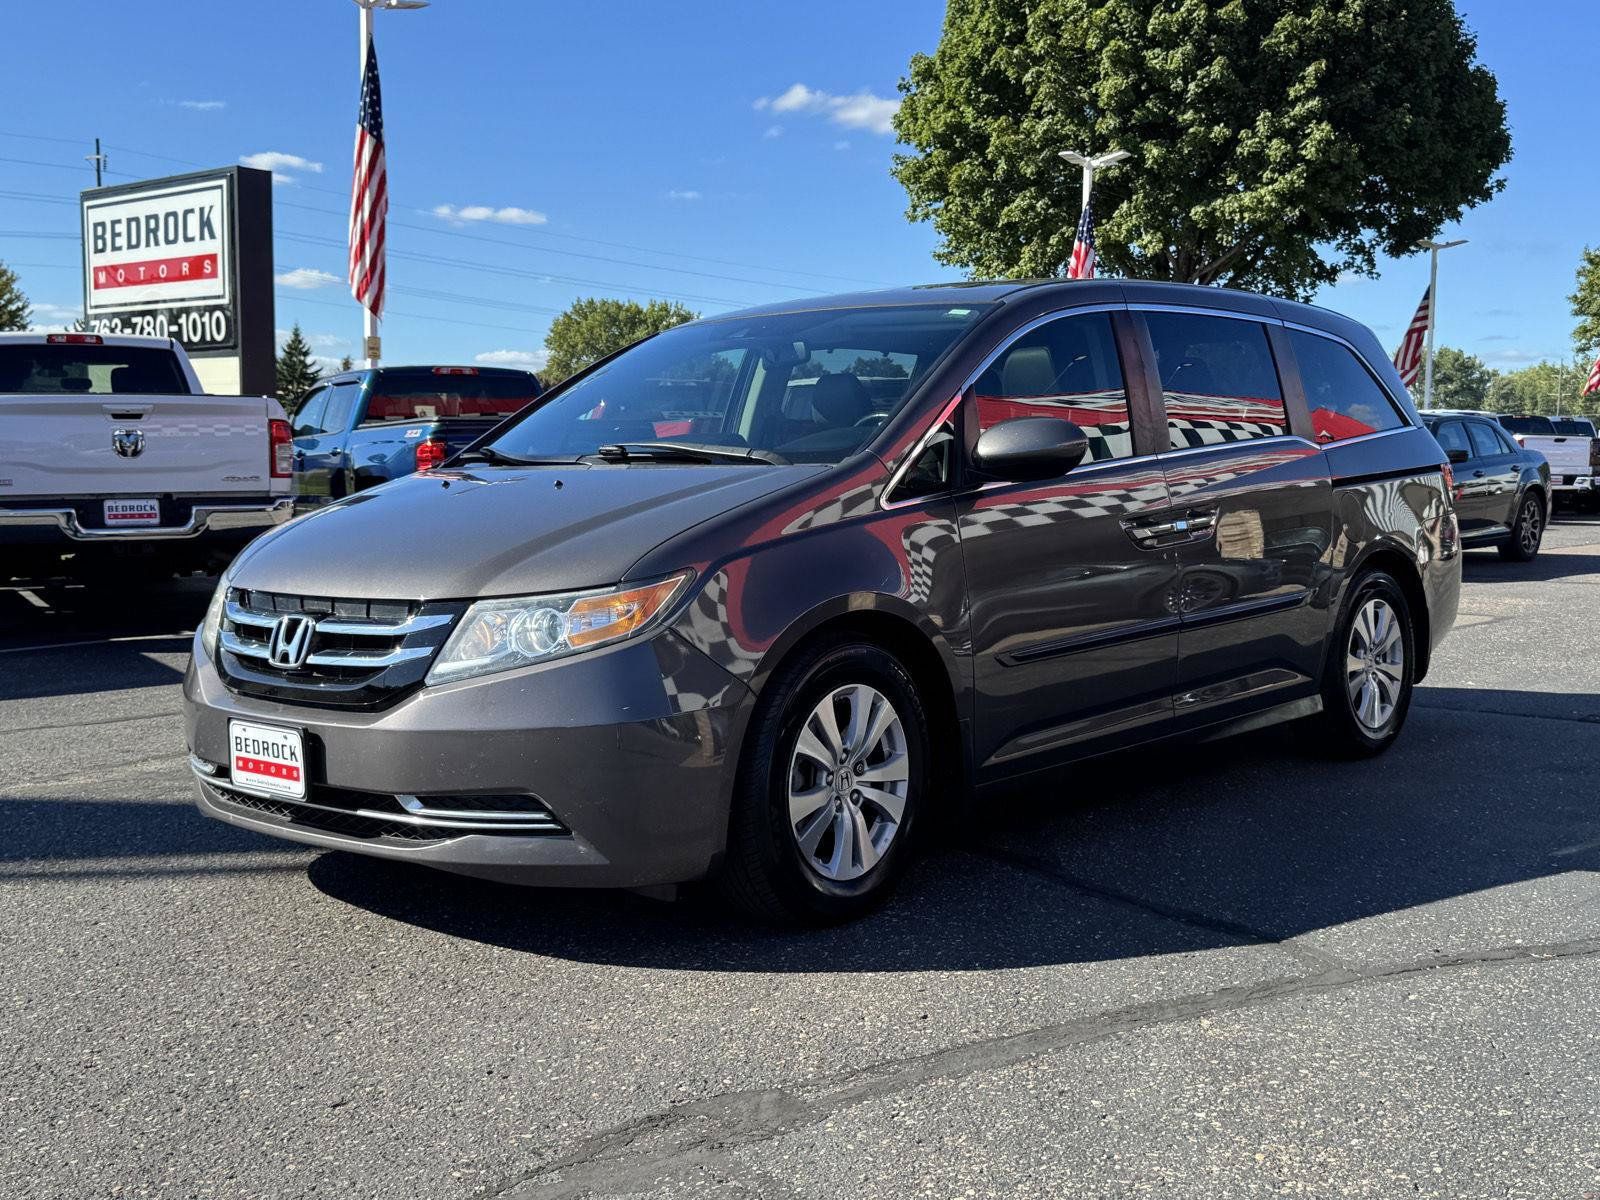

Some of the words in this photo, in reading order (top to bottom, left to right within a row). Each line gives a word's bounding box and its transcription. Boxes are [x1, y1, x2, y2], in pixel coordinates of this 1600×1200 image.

[93, 205, 216, 254] BEDROCK
[98, 259, 212, 284] MOTORS
[107, 504, 157, 512] BEDROCK
[235, 735, 299, 763] BEDROCK
[238, 759, 298, 779] MOTORS
